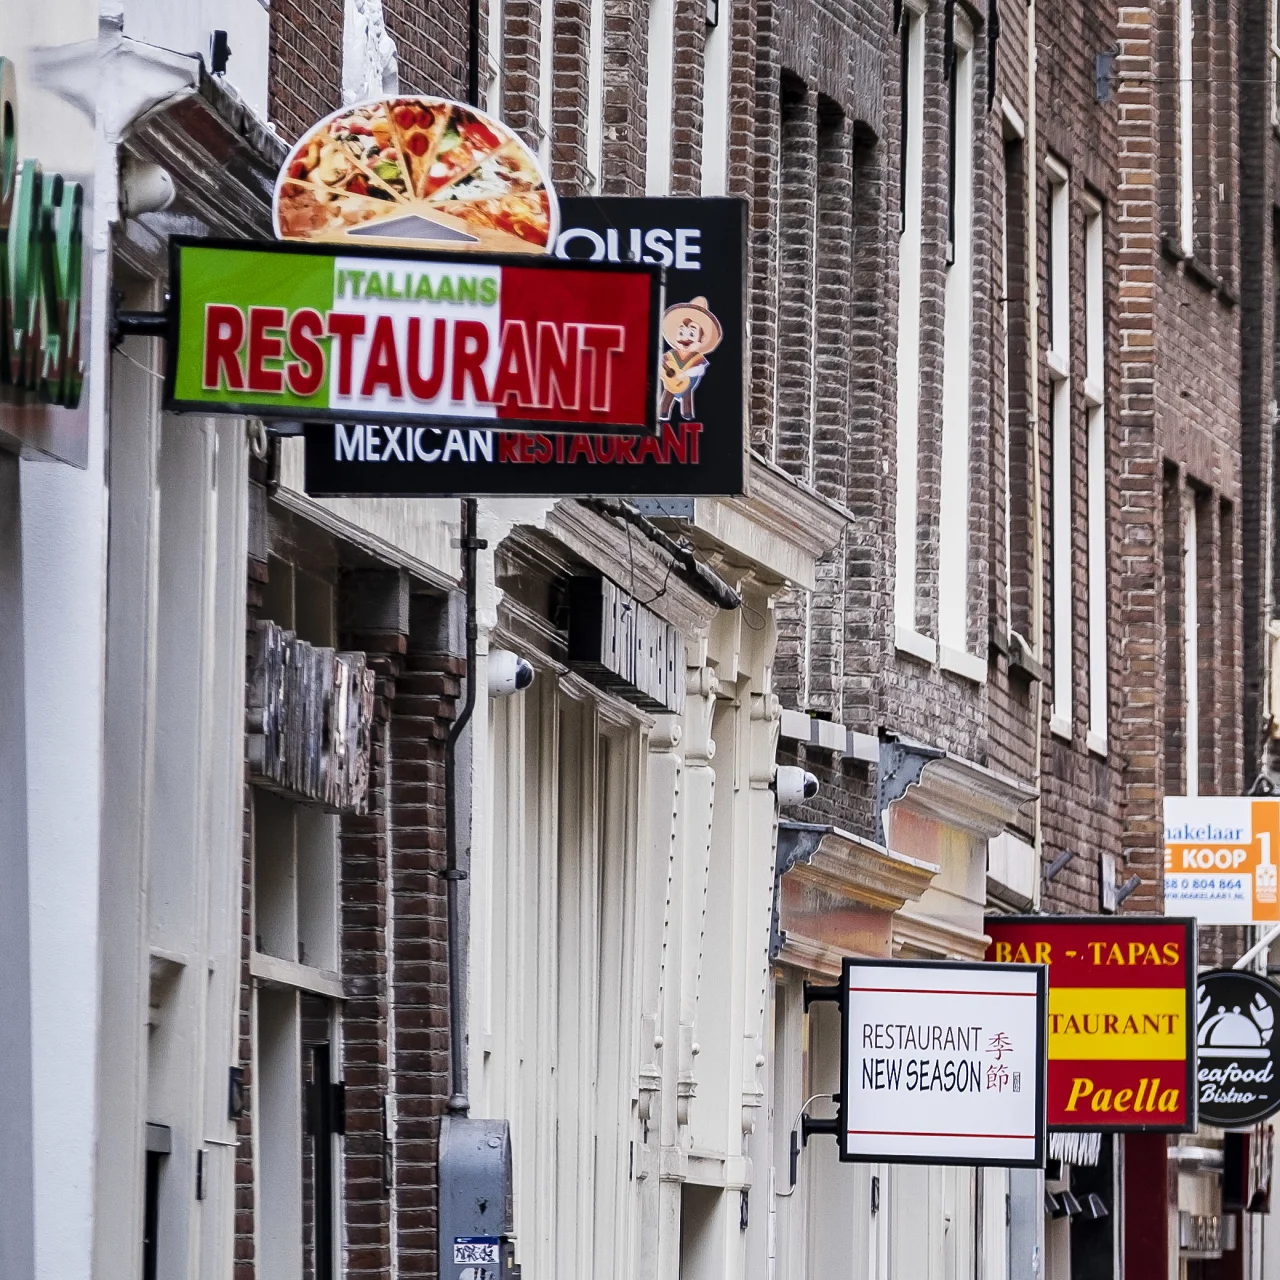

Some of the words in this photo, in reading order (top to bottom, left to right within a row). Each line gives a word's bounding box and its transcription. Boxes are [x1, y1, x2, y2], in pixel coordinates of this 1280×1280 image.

[336, 268, 498, 306] ITALIAANS
[202, 304, 626, 413] RESTAURANT
[335, 424, 494, 462] MEXICAN
[500, 424, 704, 465] RESTAURANT
[1182, 848, 1247, 869] KOOP
[995, 942, 1052, 965] BAR
[1087, 941, 1181, 967] TAPAS
[862, 1023, 983, 1052] RESTAURANT
[862, 1057, 903, 1091] NEW
[906, 1058, 982, 1093] SEASON
[985, 1031, 1014, 1093] 季節
[1197, 1060, 1274, 1084] eafood
[1064, 1077, 1180, 1113] Paella
